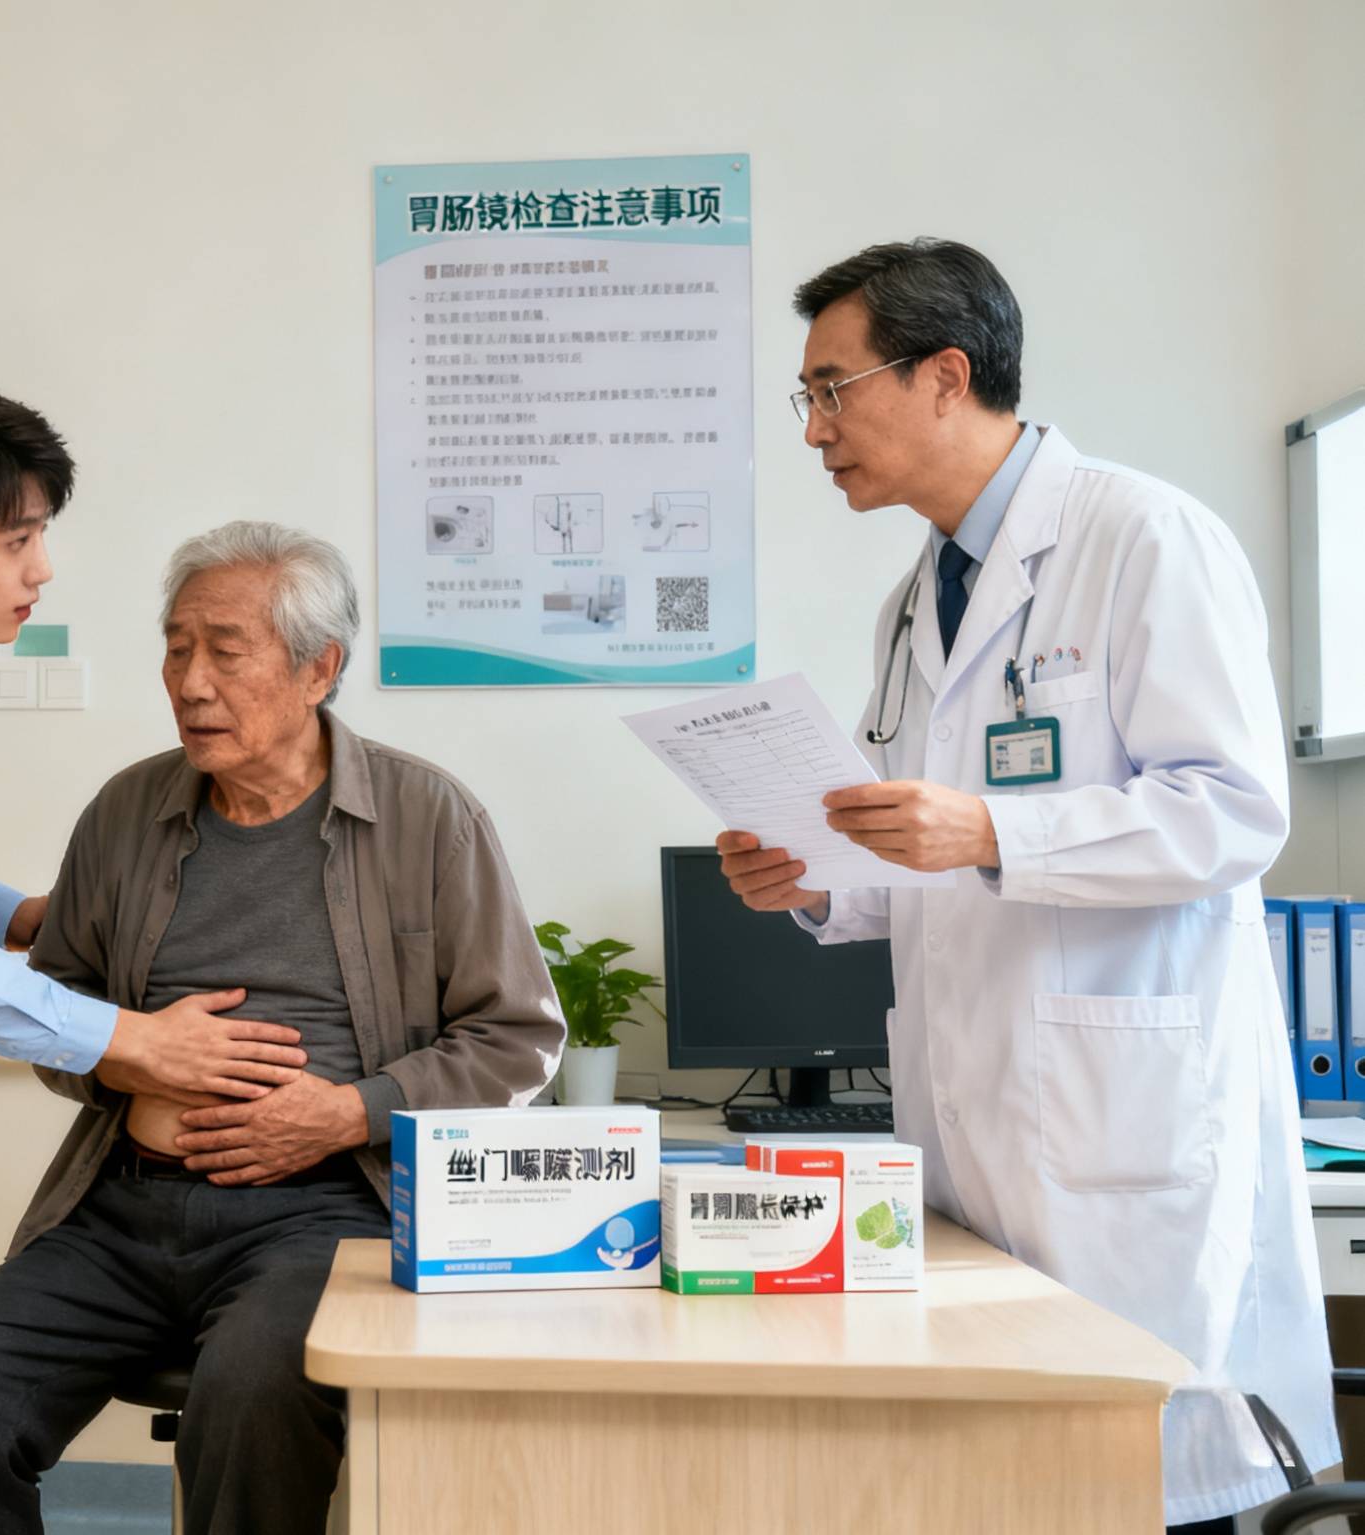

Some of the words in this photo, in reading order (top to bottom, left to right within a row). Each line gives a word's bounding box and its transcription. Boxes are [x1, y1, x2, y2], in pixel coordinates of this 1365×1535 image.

[409, 185, 722, 232] 胃肠镜检查注意事项
